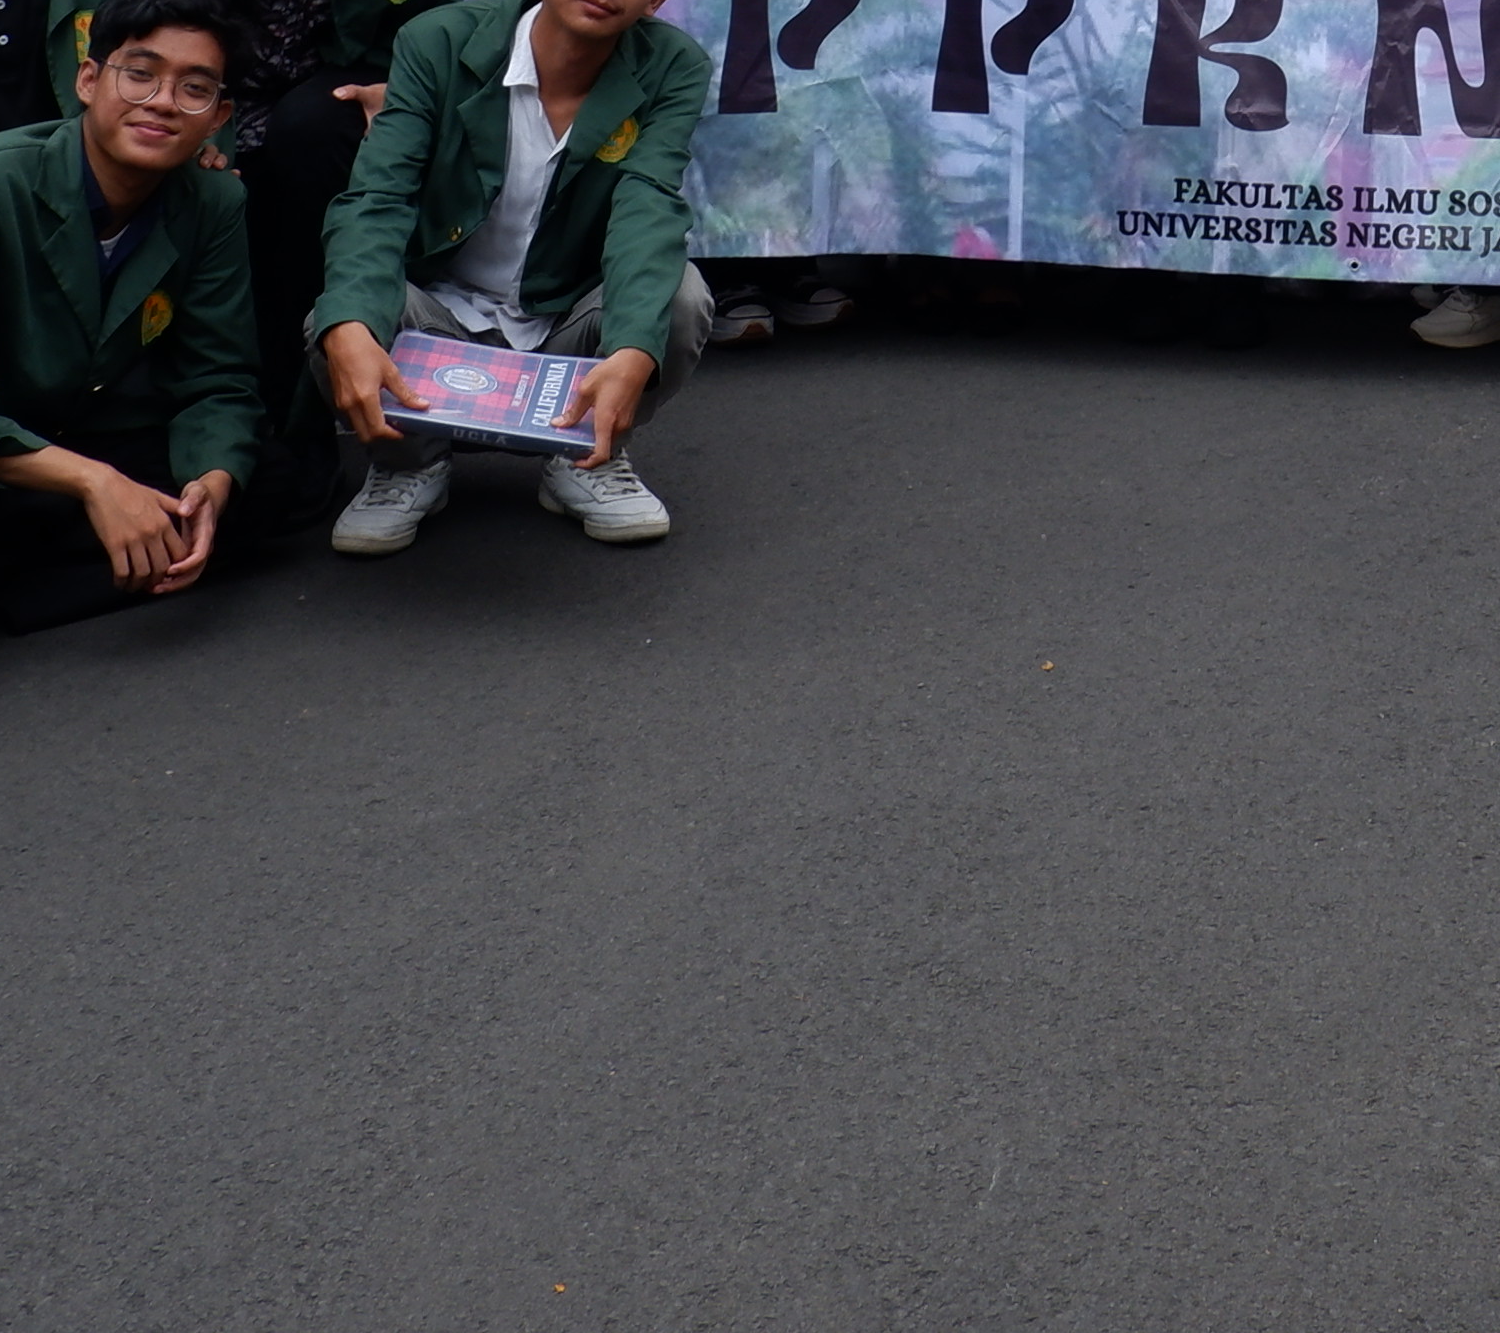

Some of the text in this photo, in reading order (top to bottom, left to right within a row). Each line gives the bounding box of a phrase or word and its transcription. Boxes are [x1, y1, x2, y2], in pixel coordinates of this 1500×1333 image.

[1173, 178, 1344, 212] FAKULTAS
[1352, 185, 1440, 216] ILMU
[1116, 210, 1337, 248] UNIVERSITAS
[1345, 221, 1472, 252] NEGERI
[531, 361, 569, 428] CALIFORNIA
